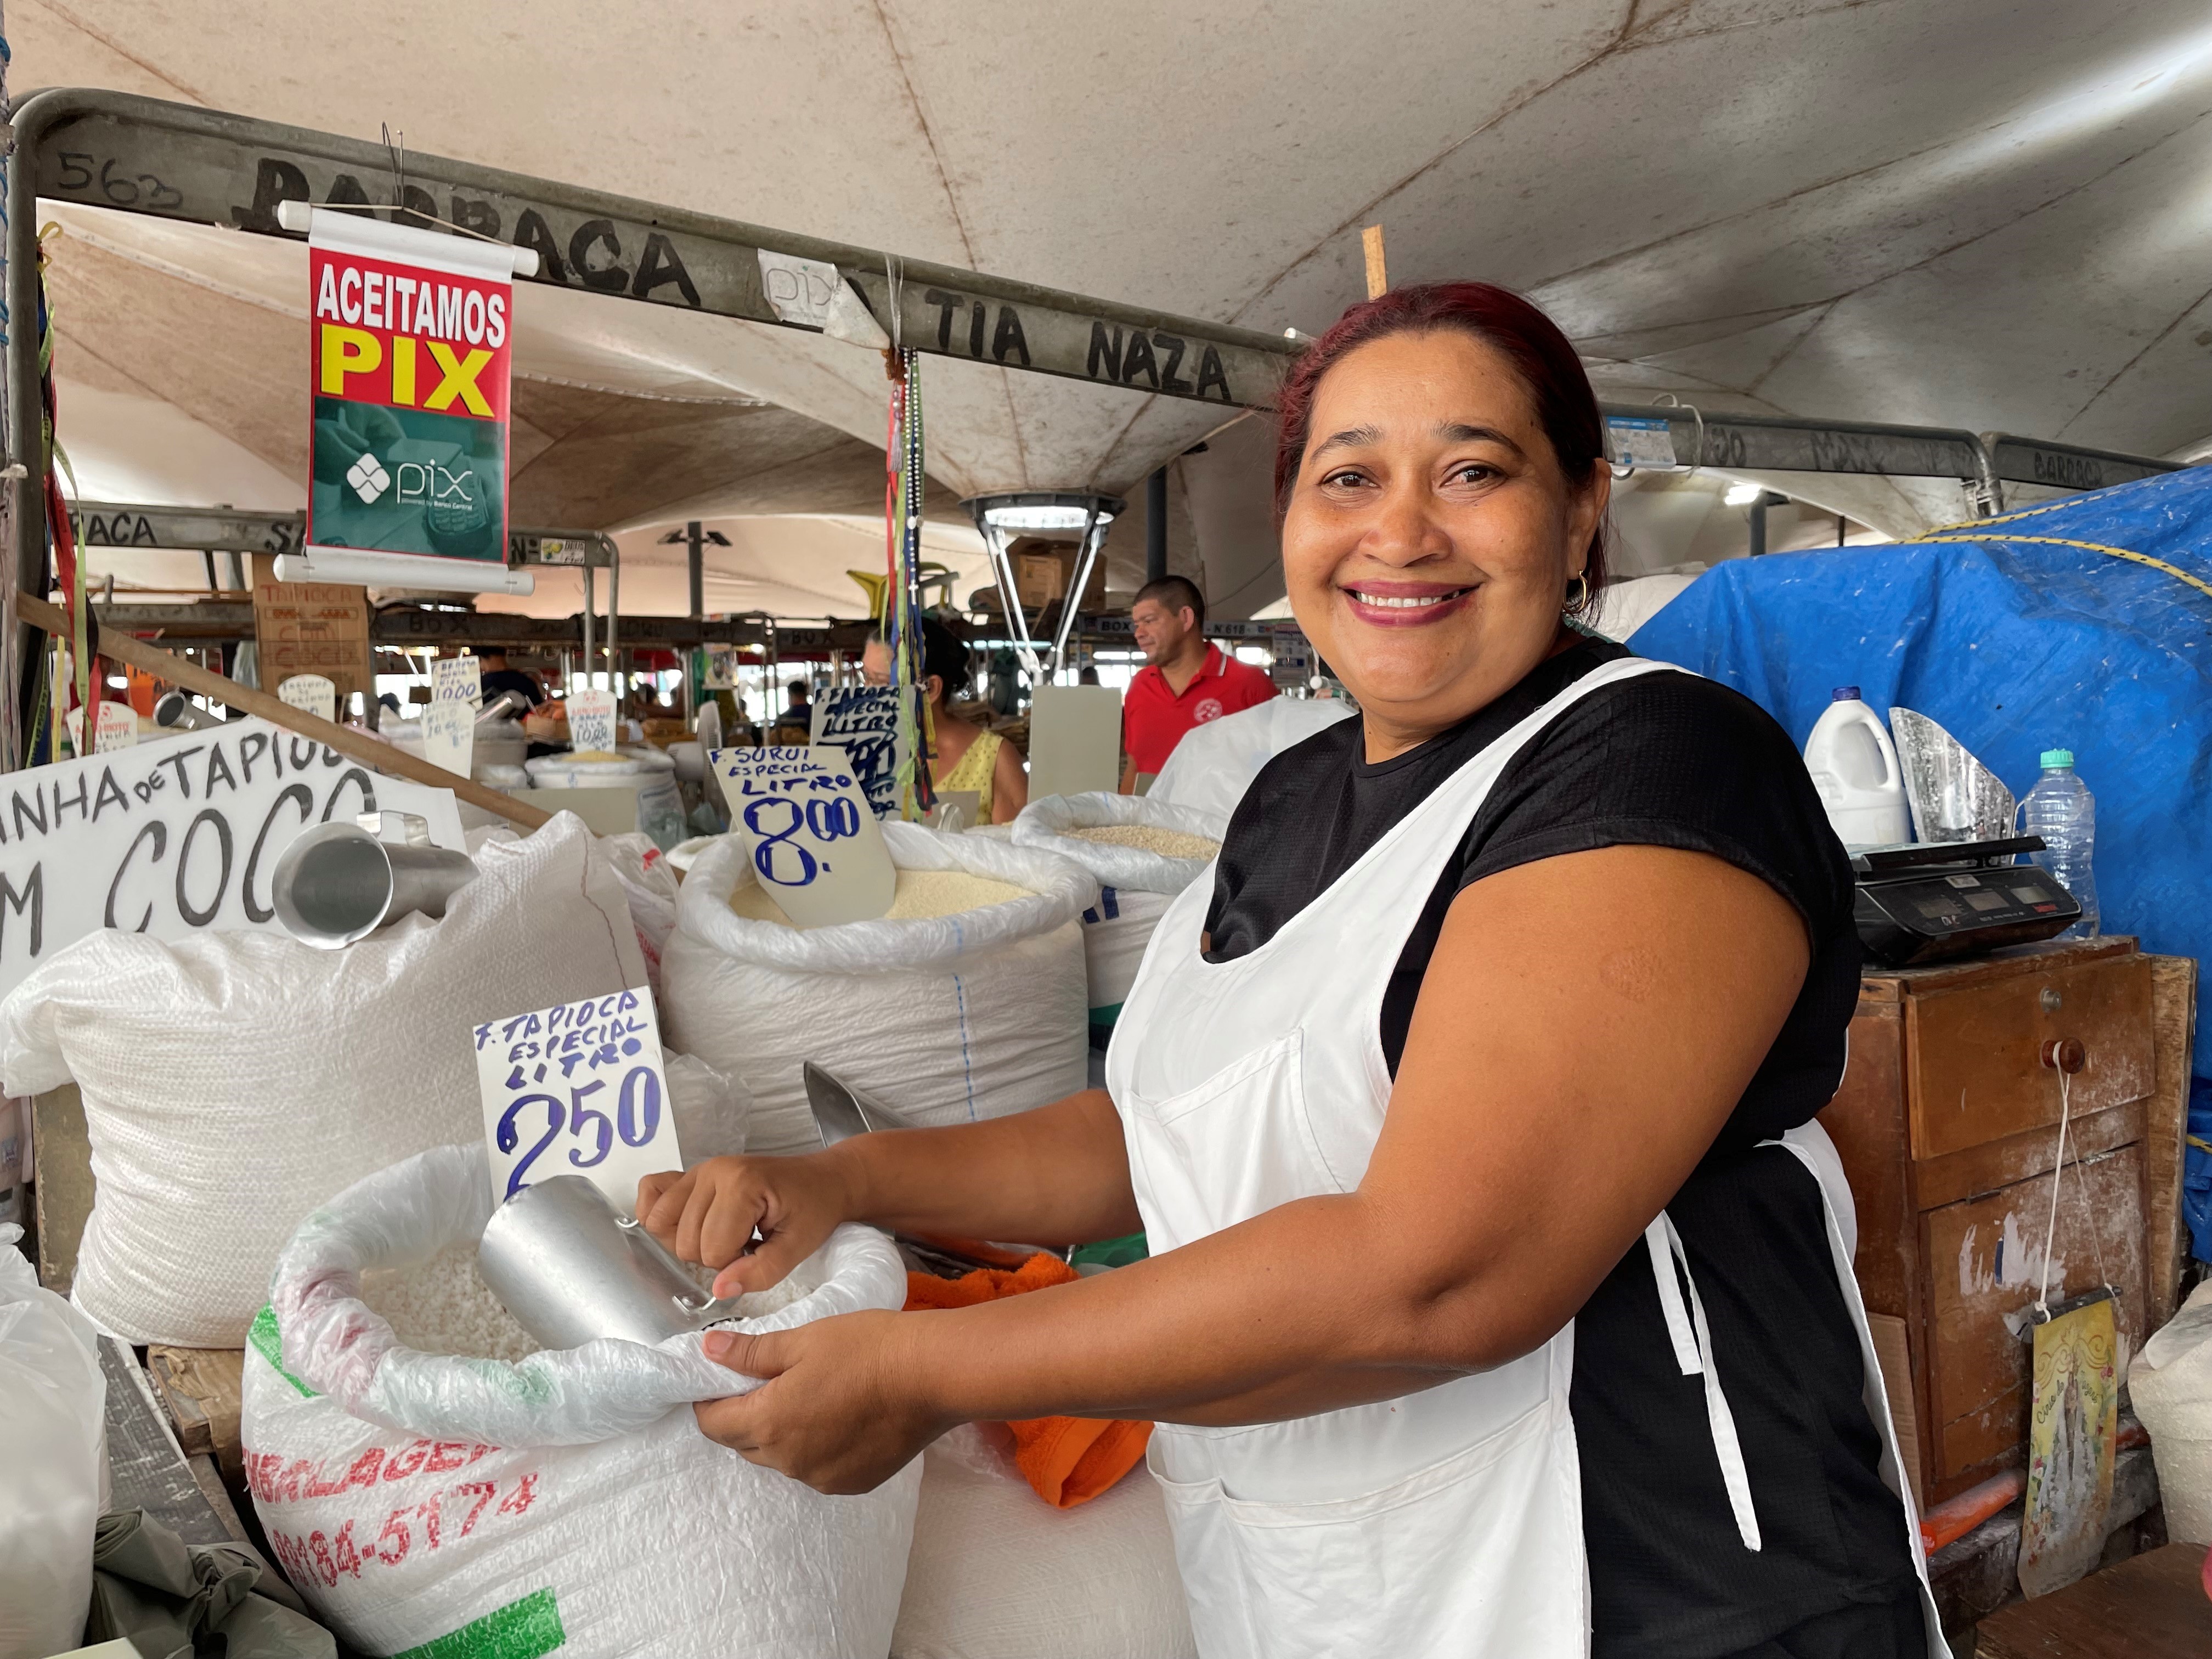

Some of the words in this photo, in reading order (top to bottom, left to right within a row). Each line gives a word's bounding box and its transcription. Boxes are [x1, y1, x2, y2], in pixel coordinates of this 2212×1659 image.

[316, 263, 506, 348] ACEITAMOS
[320, 323, 495, 417] PIX
[925, 289, 1031, 366] TIA
[1087, 320, 1232, 401] NAZA
[397, 458, 472, 504] pix
[1101, 621, 1131, 631] BOX
[156, 731, 383, 799] TAPIO
[710, 750, 727, 764] F.
[735, 748, 810, 763] SURUI
[729, 763, 827, 777] ESPECIAL
[741, 774, 853, 795] LITRO
[473, 1022, 496, 1051] F.
[501, 990, 639, 1043] TAPIOCA
[507, 1015, 648, 1063] ESPECIAL
[505, 1037, 642, 1090] LITRO
